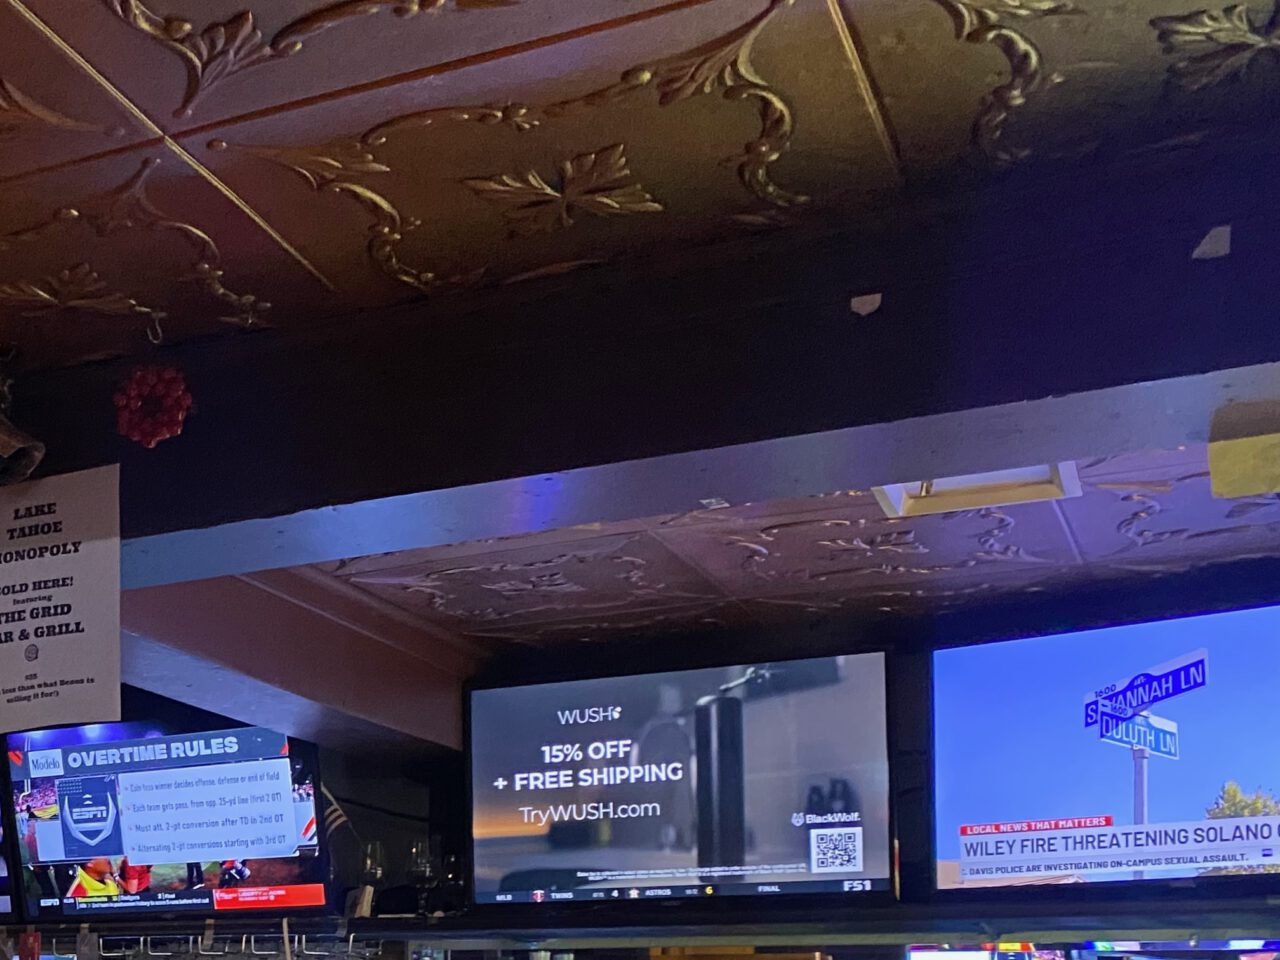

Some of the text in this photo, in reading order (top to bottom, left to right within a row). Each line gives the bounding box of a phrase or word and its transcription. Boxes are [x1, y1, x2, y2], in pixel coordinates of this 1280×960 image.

[13, 502, 56, 520] LAKE
[6, 521, 63, 540] TAHOE
[32, 576, 73, 592] HERE!
[13, 594, 53, 605] featuring
[30, 603, 72, 620] GRID
[18, 629, 30, 641] &
[34, 622, 84, 639] GRILL
[18, 684, 35, 692] than
[1087, 664, 1203, 723] SANNAH LN
[558, 706, 614, 725] WUSH
[1102, 715, 1175, 754] DULUTH LN
[68, 737, 239, 768] OVERTIME RULES
[541, 739, 631, 763] 15% OFF
[32, 757, 60, 771] Modelo
[130, 784, 141, 792] Coin
[174, 780, 193, 789] decides
[218, 776, 239, 785] defense
[248, 774, 257, 782] end
[259, 773, 265, 781] of
[266, 772, 280, 781] field
[493, 762, 683, 791] + FREE SHIPPING
[72, 805, 107, 819] ESPN
[133, 804, 146, 812] Each
[162, 802, 174, 813] gets
[190, 800, 204, 808] from
[519, 801, 660, 826] TryWUSH.com
[135, 824, 151, 832] Must
[166, 822, 181, 832] 2-pt
[182, 817, 220, 830] conversion
[221, 817, 238, 827] after
[239, 816, 249, 825] TD
[251, 816, 257, 824] in
[259, 815, 272, 824] 2nd
[275, 814, 284, 822] OT
[966, 817, 1107, 835] LOCAL NEWS THAT MATTERS
[138, 841, 173, 854] Alternating
[186, 838, 223, 850] conversions
[224, 836, 249, 848] starting
[250, 837, 264, 845] with
[964, 823, 1272, 858] WILEY FIRE THREATENING SOLANO
[969, 853, 1249, 876] DAVIS POLICE ARE INVESTIGATING ON-CAMPUS SEXUAL ASSAULT.
[705, 886, 713, 895] 6
[758, 885, 780, 893] FINAL
